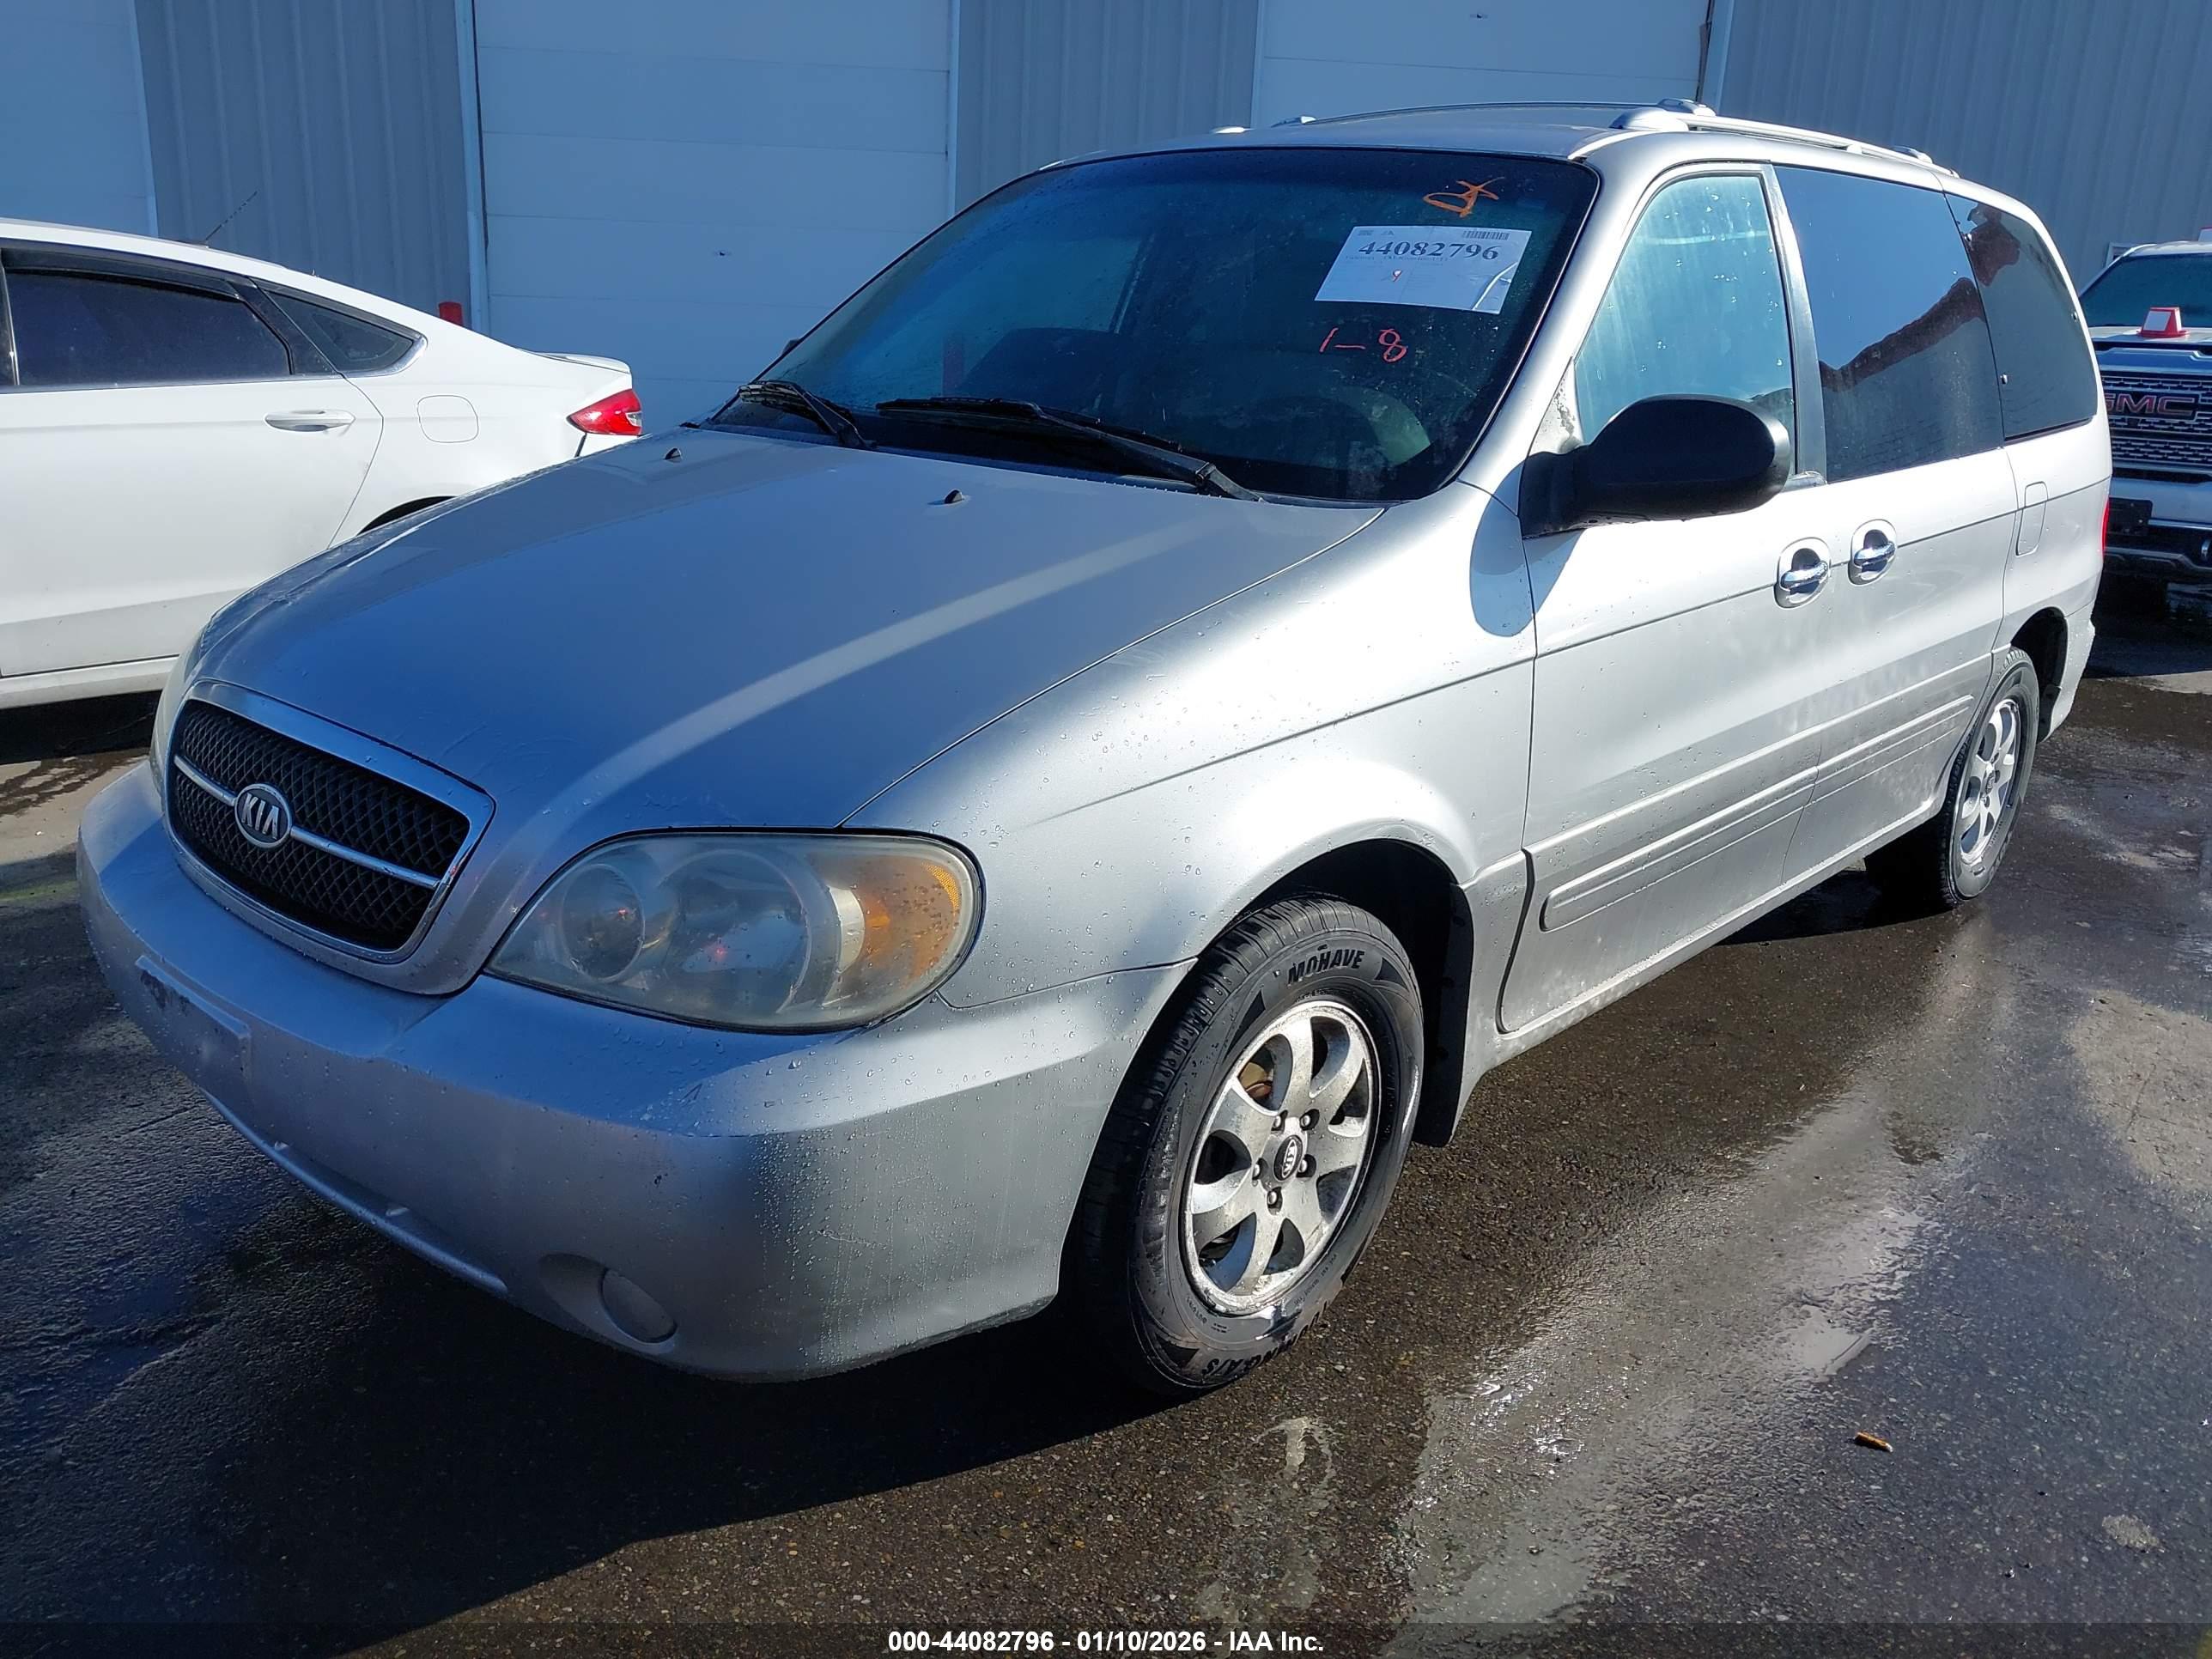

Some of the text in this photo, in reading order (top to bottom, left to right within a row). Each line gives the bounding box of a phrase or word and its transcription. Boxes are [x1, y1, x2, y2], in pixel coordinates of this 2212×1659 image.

[1358, 240, 1500, 260] 44082796
[241, 793, 280, 840] KIA
[1288, 949, 1365, 984] MOHAVE
